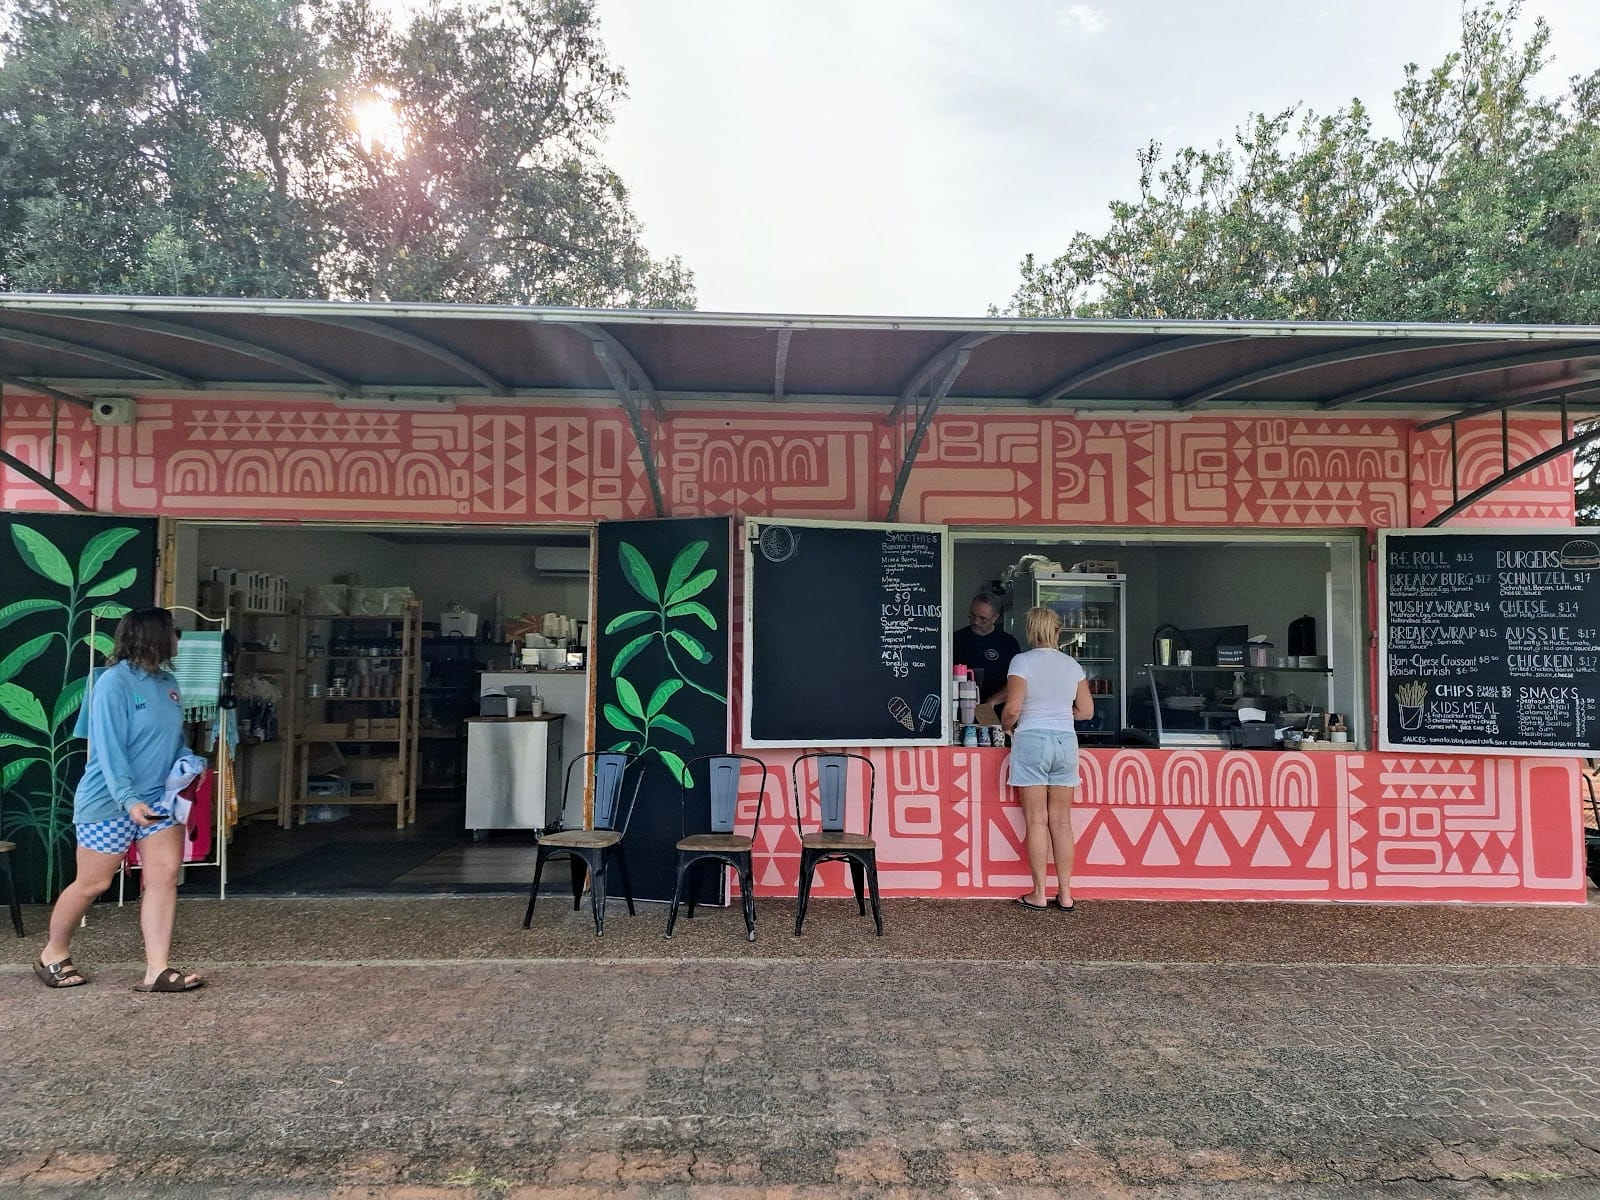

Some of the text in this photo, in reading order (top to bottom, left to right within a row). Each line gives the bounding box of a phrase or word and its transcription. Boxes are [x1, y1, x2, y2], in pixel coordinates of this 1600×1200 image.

[1413, 551, 1448, 565] ROLL
[1456, 552, 1474, 562] $13
[1496, 550, 1560, 569] BURGERS
[1389, 572, 1492, 586] BREAKY BURG $17
[1498, 571, 1591, 585] SCHNITZEL $17
[894, 591, 911, 604] $9
[881, 603, 942, 618] ICY BLENDS
[1389, 600, 1491, 613] MUSHY WRAP $14
[1498, 600, 1579, 613] CHEESE $14
[880, 616, 908, 627] Sunrise
[880, 635, 906, 644] Tropical
[1389, 626, 1497, 640] BREAKY WRAP $15
[1505, 626, 1597, 641] AUSSIE $17
[1389, 653, 1408, 667] Ham
[1440, 653, 1477, 667] Croissant
[1507, 654, 1598, 668] CHICKEN $17
[893, 666, 909, 678] $9
[1389, 665, 1417, 677] Raisin
[1419, 665, 1451, 677] Turkish
[1435, 684, 1474, 698] CHIPS
[1519, 686, 1579, 700] SNACKS
[1430, 700, 1500, 714] KIDS MEAL
[1485, 724, 1500, 734] $8
